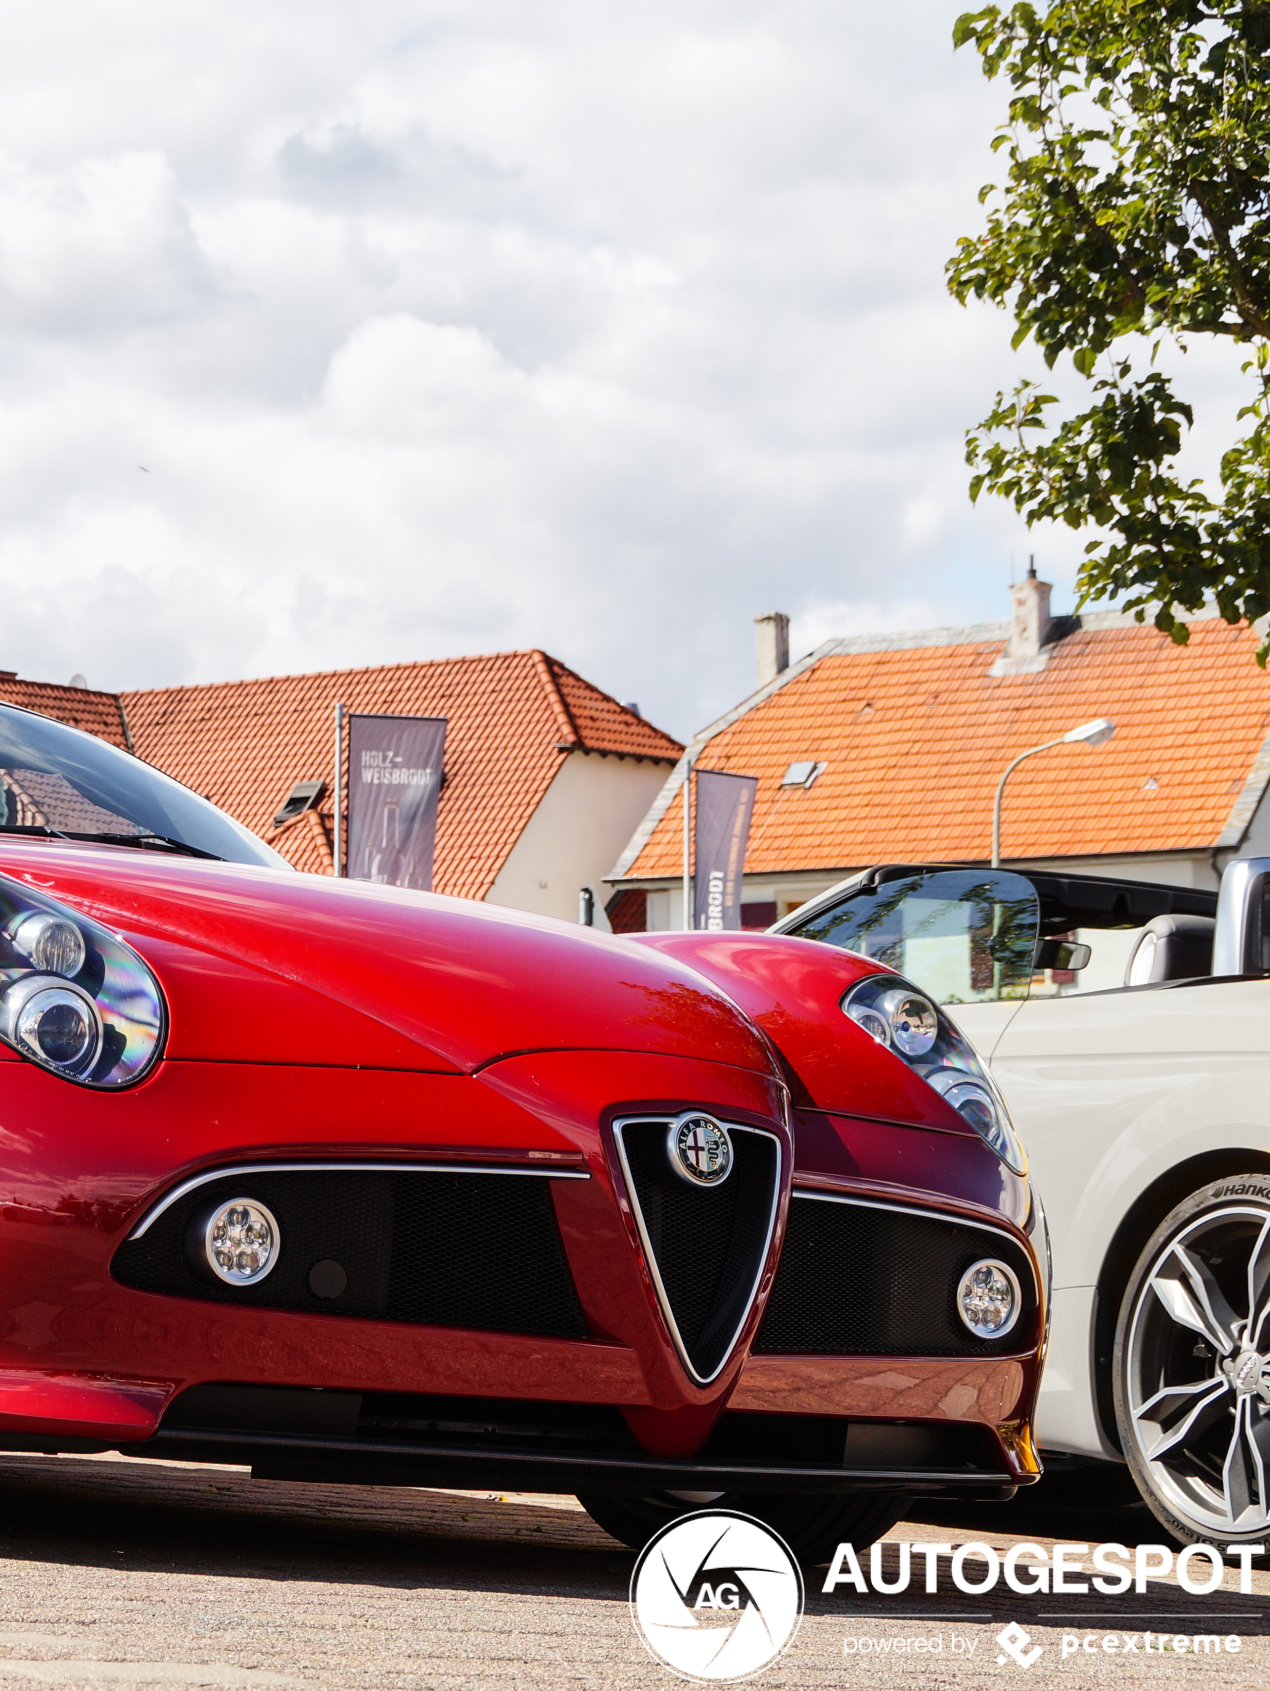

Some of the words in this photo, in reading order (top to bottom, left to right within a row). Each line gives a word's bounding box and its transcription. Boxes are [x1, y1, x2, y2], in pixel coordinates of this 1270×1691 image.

[361, 750, 404, 768] HOLZ-
[361, 768, 433, 785] WEISBRODT
[679, 1122, 696, 1150] ALFA
[699, 1120, 728, 1153] ROMEO
